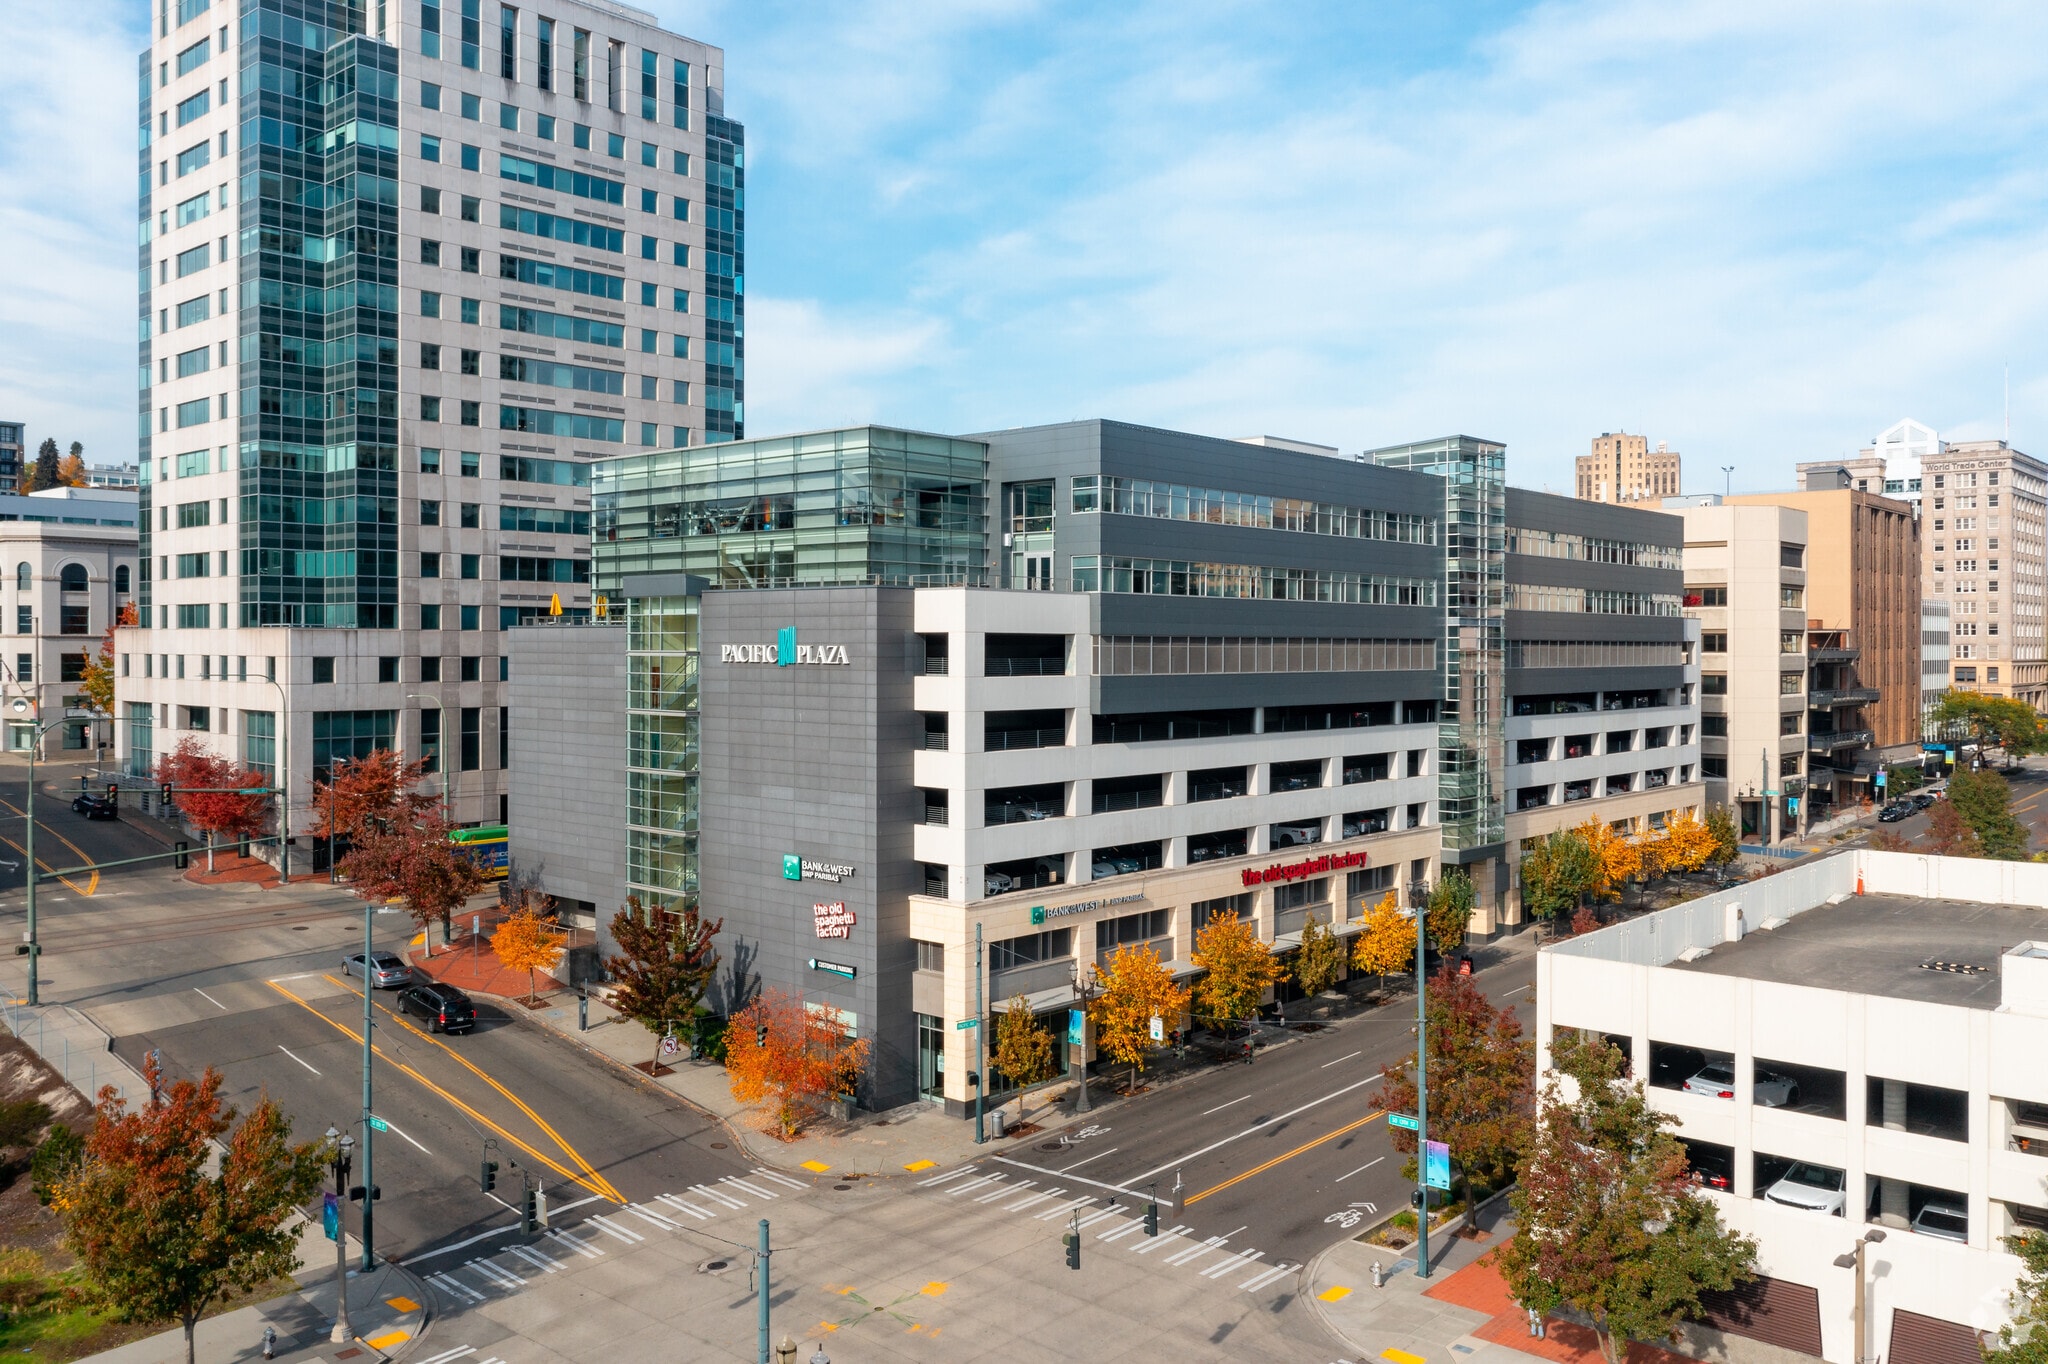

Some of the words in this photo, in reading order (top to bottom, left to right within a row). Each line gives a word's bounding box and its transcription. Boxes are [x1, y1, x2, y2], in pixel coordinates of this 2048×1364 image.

[1926, 463, 1950, 471] World
[1952, 462, 1976, 470] Trade
[1978, 460, 2007, 468] Center
[721, 644, 778, 664] PACIFIC
[797, 645, 849, 665] PLAZA
[801, 860, 823, 872] BANK
[830, 864, 854, 876] WEST
[801, 870, 814, 878] BNP
[1242, 868, 1262, 886] the
[1263, 864, 1281, 882] old
[1281, 855, 1330, 882] spaghetti
[1331, 851, 1367, 869] factory
[813, 904, 828, 915] the
[829, 902, 843, 914] old
[1047, 905, 1070, 918] BANK
[1077, 901, 1098, 912] WEST
[814, 912, 855, 928] spaghetti
[815, 926, 848, 938] factory
